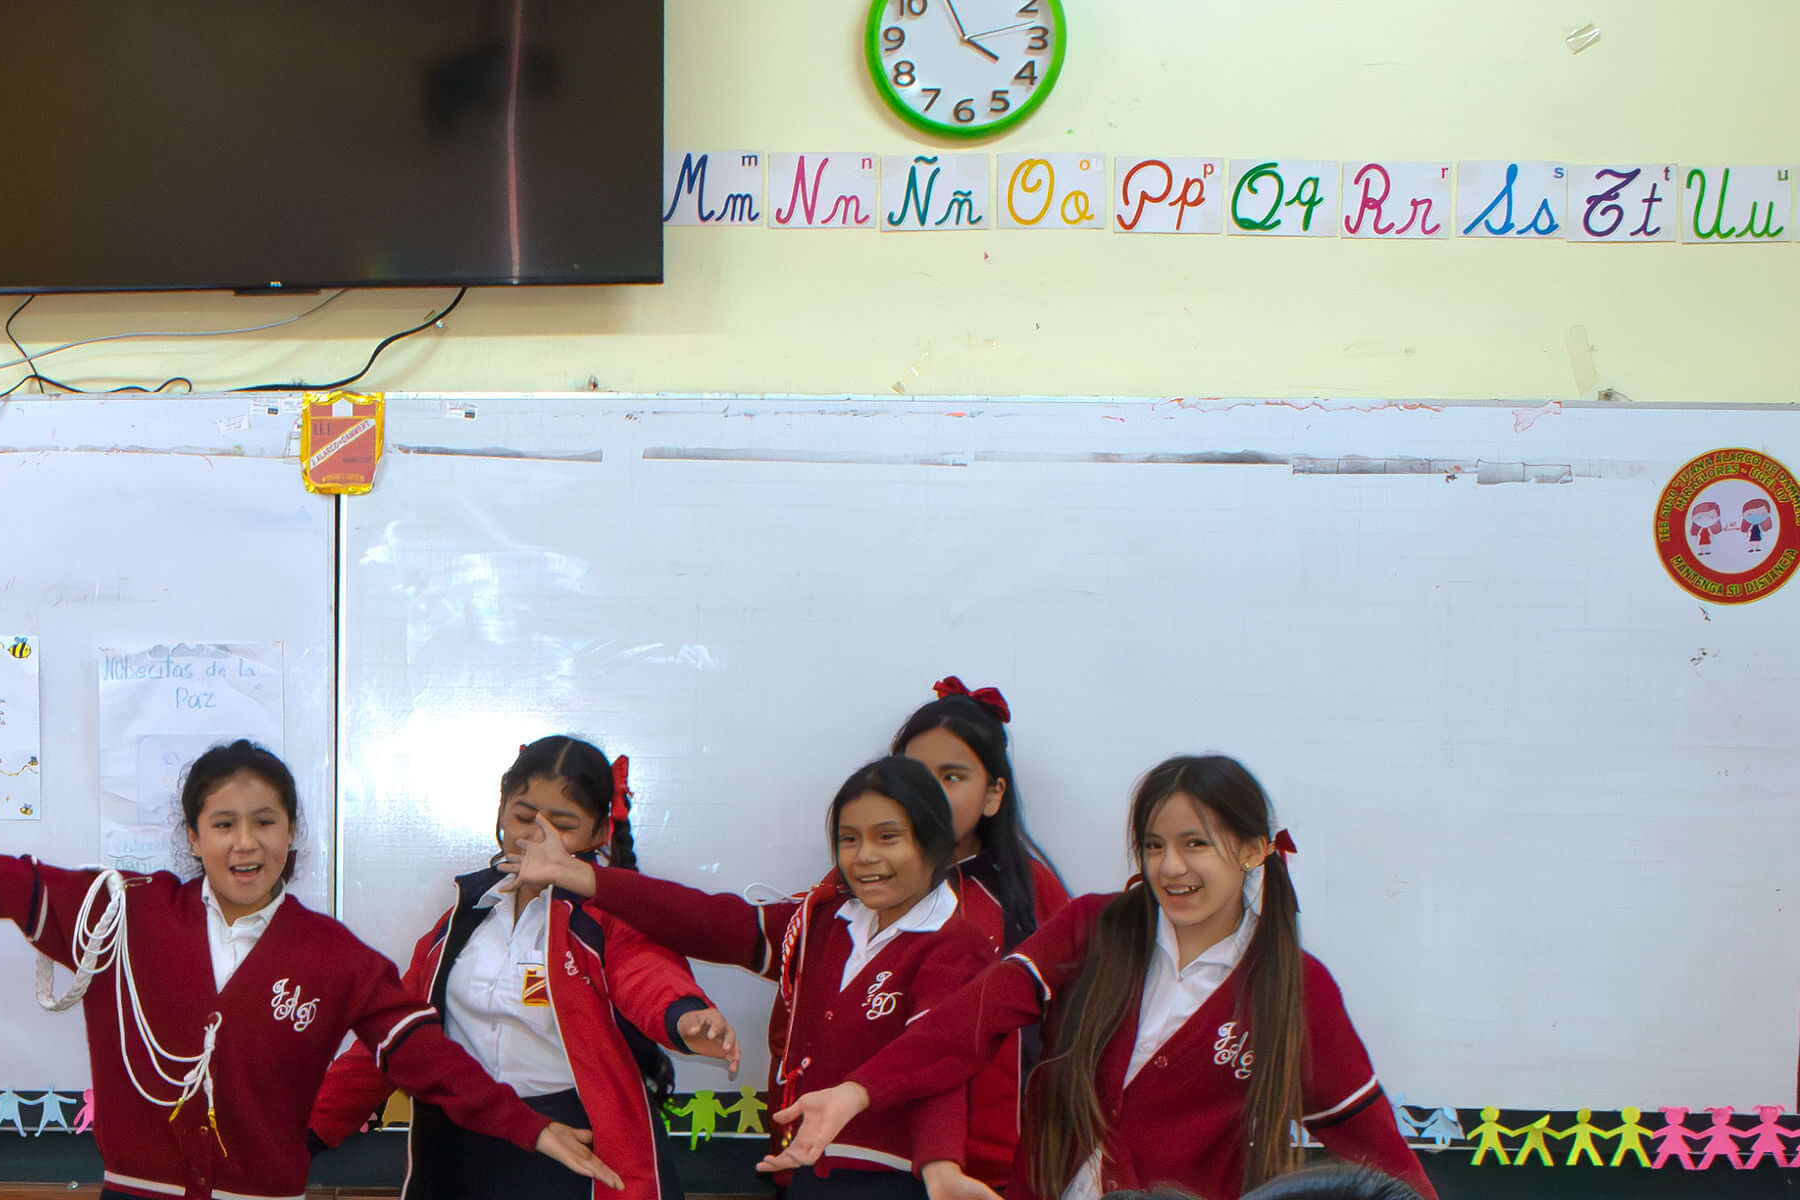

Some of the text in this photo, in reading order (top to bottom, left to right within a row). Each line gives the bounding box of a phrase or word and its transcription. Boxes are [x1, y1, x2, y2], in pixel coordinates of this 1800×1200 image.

[882, 26, 906, 52] 9
[1013, 60, 1038, 85] 4
[1027, 26, 1049, 51] 3
[892, 60, 916, 87] 8
[920, 88, 942, 112] 7
[988, 89, 1010, 113] 5
[953, 98, 975, 123] 6
[662, 152, 760, 222] Mm
[775, 155, 870, 225] Nn
[887, 155, 983, 226] Ññ
[1007, 158, 1095, 225] Oo
[1116, 159, 1206, 231] Pp
[1231, 162, 1324, 231] Qq
[1344, 163, 1441, 235] Rr
[1463, 162, 1560, 235] Ss
[1582, 167, 1663, 237] Tt
[1686, 167, 1785, 239] Uu
[1670, 547, 1797, 597] MANTENGA SU DISTANCIA
